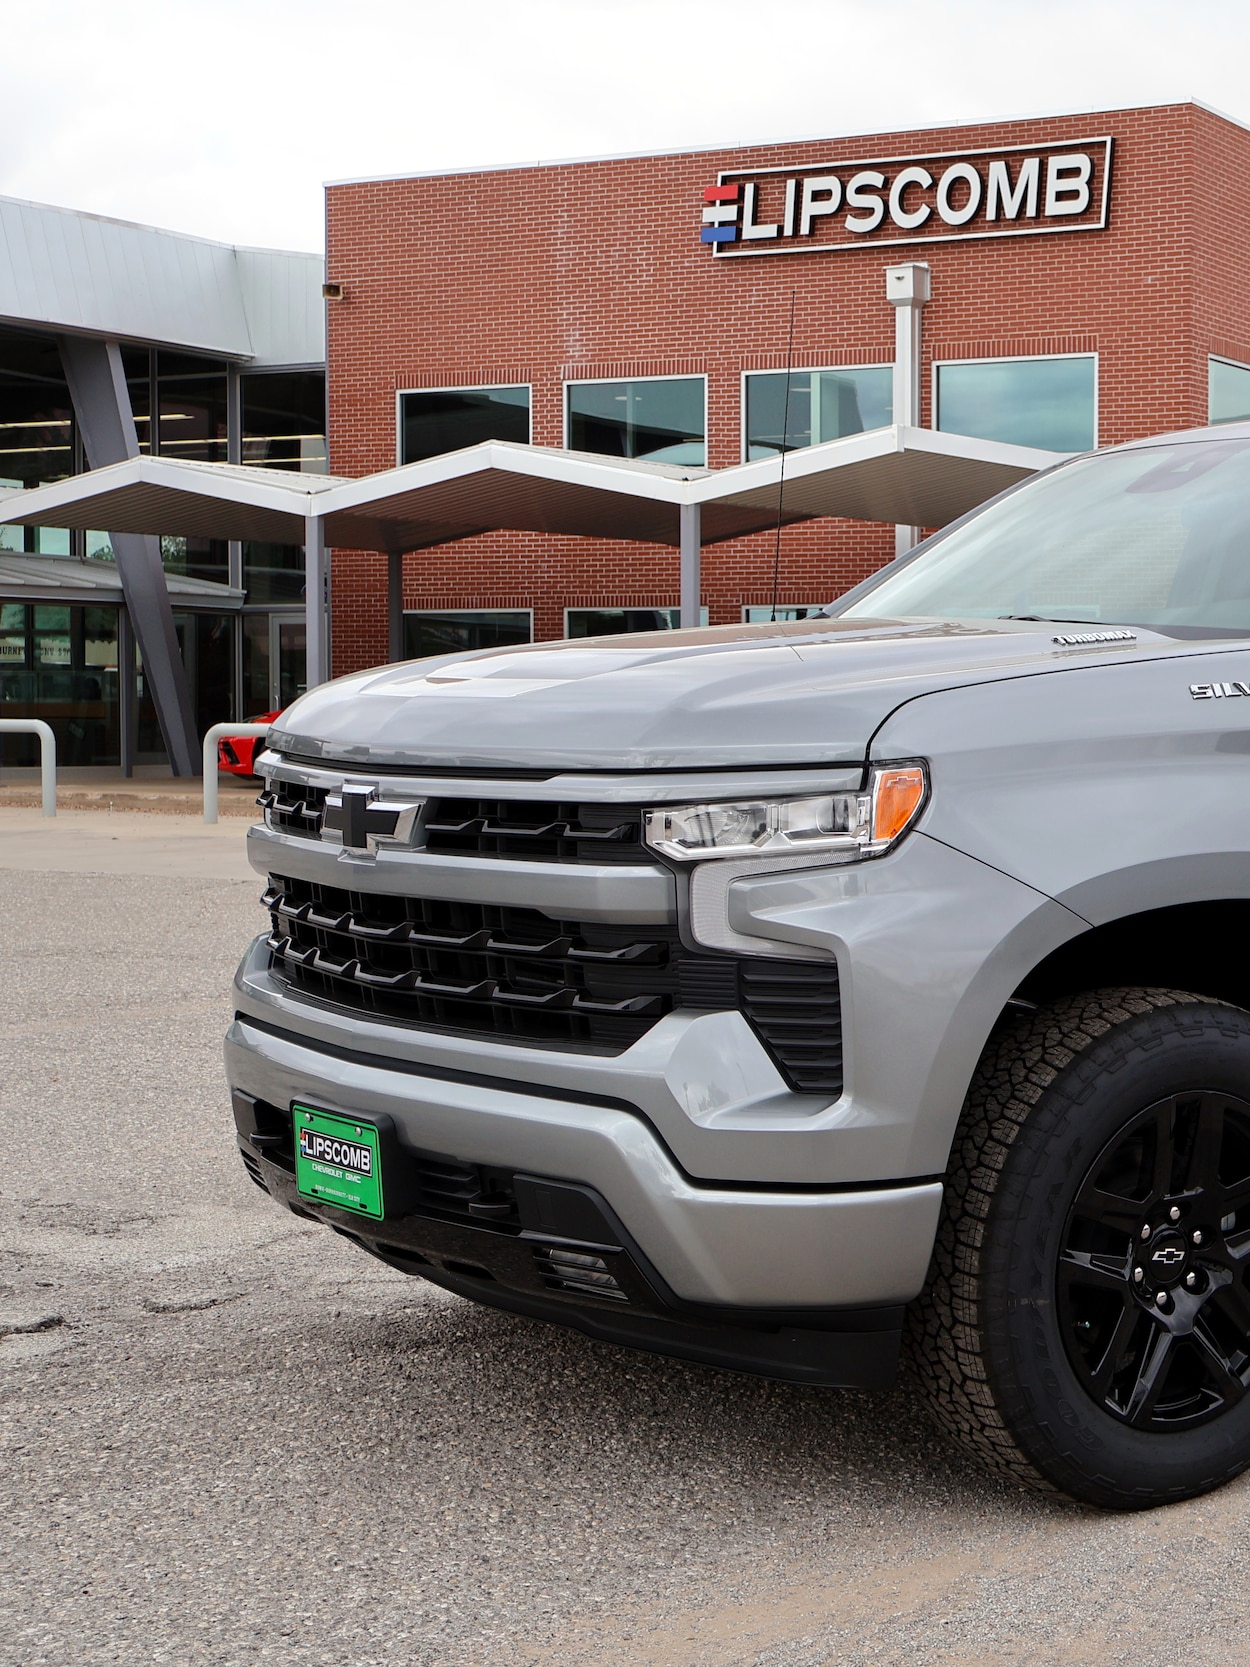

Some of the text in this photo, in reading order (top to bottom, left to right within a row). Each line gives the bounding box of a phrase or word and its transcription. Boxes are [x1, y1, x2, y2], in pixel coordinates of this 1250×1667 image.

[741, 153, 1093, 240] LIPSCOMB
[1052, 629, 1137, 647] TURBOMAX
[305, 1134, 370, 1171] LIPSCOMB
[311, 1163, 362, 1184] CHEVROLET GMC
